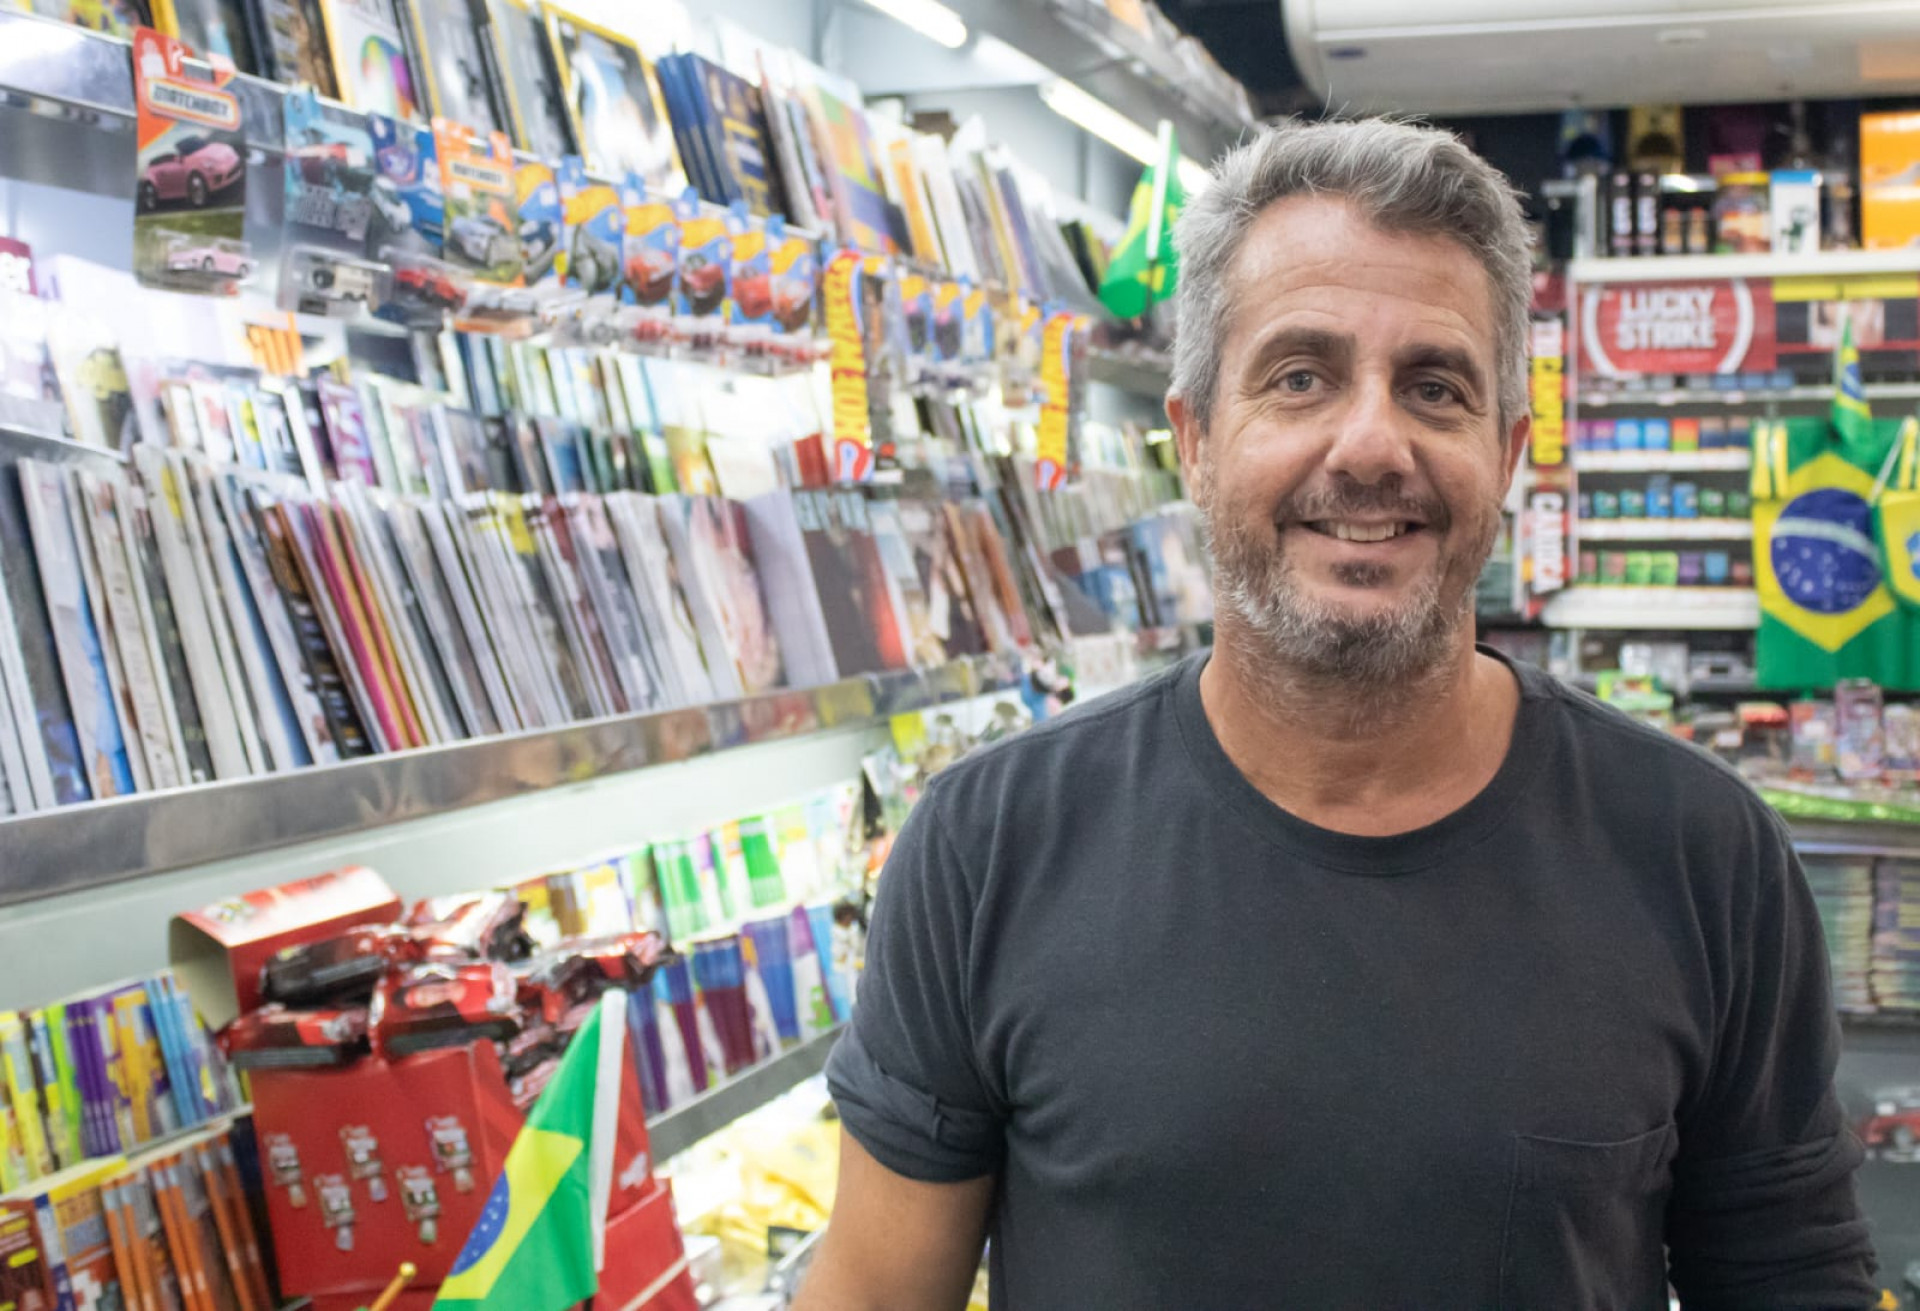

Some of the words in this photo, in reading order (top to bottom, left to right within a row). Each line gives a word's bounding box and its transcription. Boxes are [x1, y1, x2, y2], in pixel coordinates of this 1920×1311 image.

[152, 85, 230, 118] MATCHBOX
[1619, 289, 1715, 319] LUCKY
[1617, 320, 1717, 349] STRIKE
